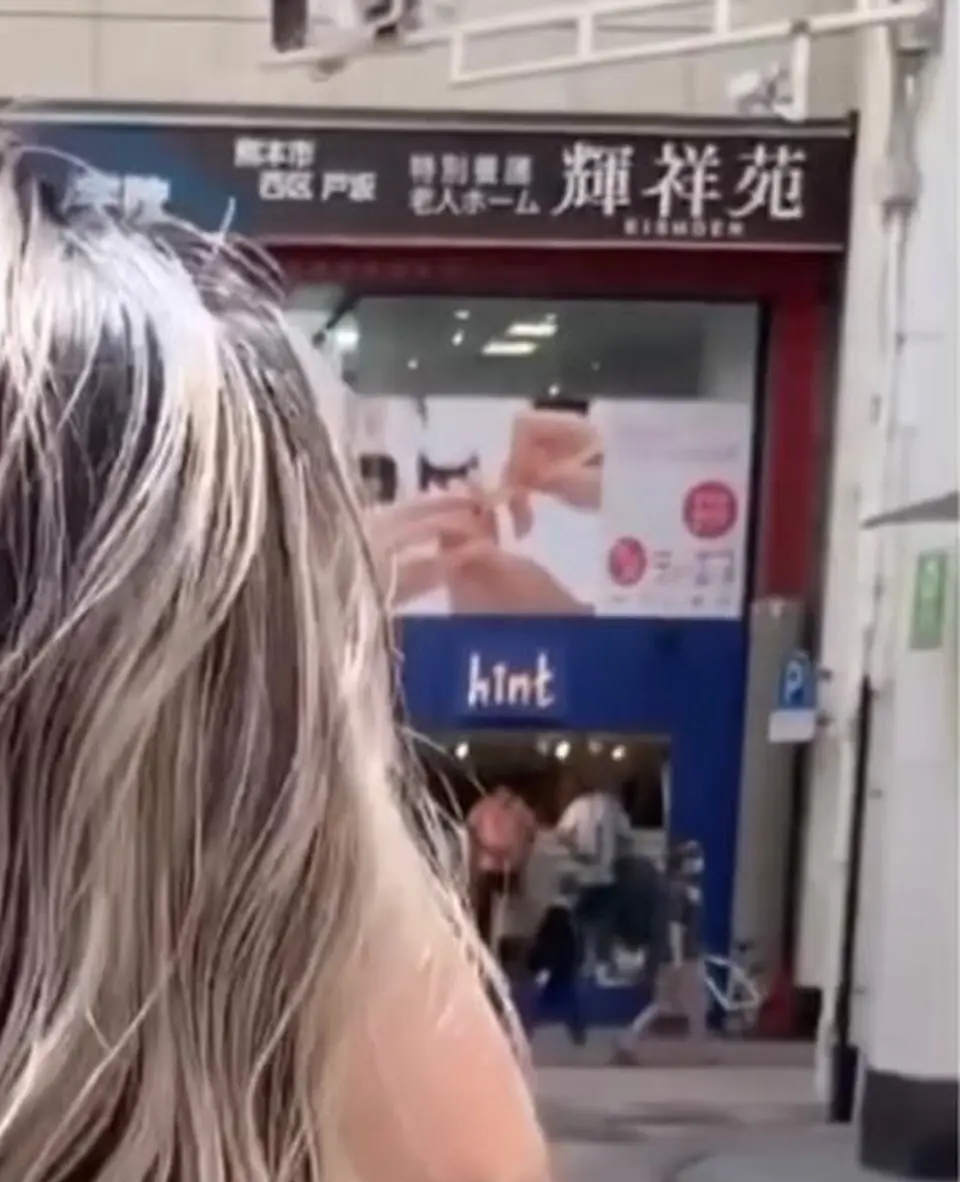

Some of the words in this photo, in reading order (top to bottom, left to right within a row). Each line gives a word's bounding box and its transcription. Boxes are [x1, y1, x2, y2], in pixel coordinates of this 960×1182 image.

[409, 186, 540, 216] 老人ホーム
[549, 141, 806, 219] 輝祥苑
[467, 651, 555, 709] hint
